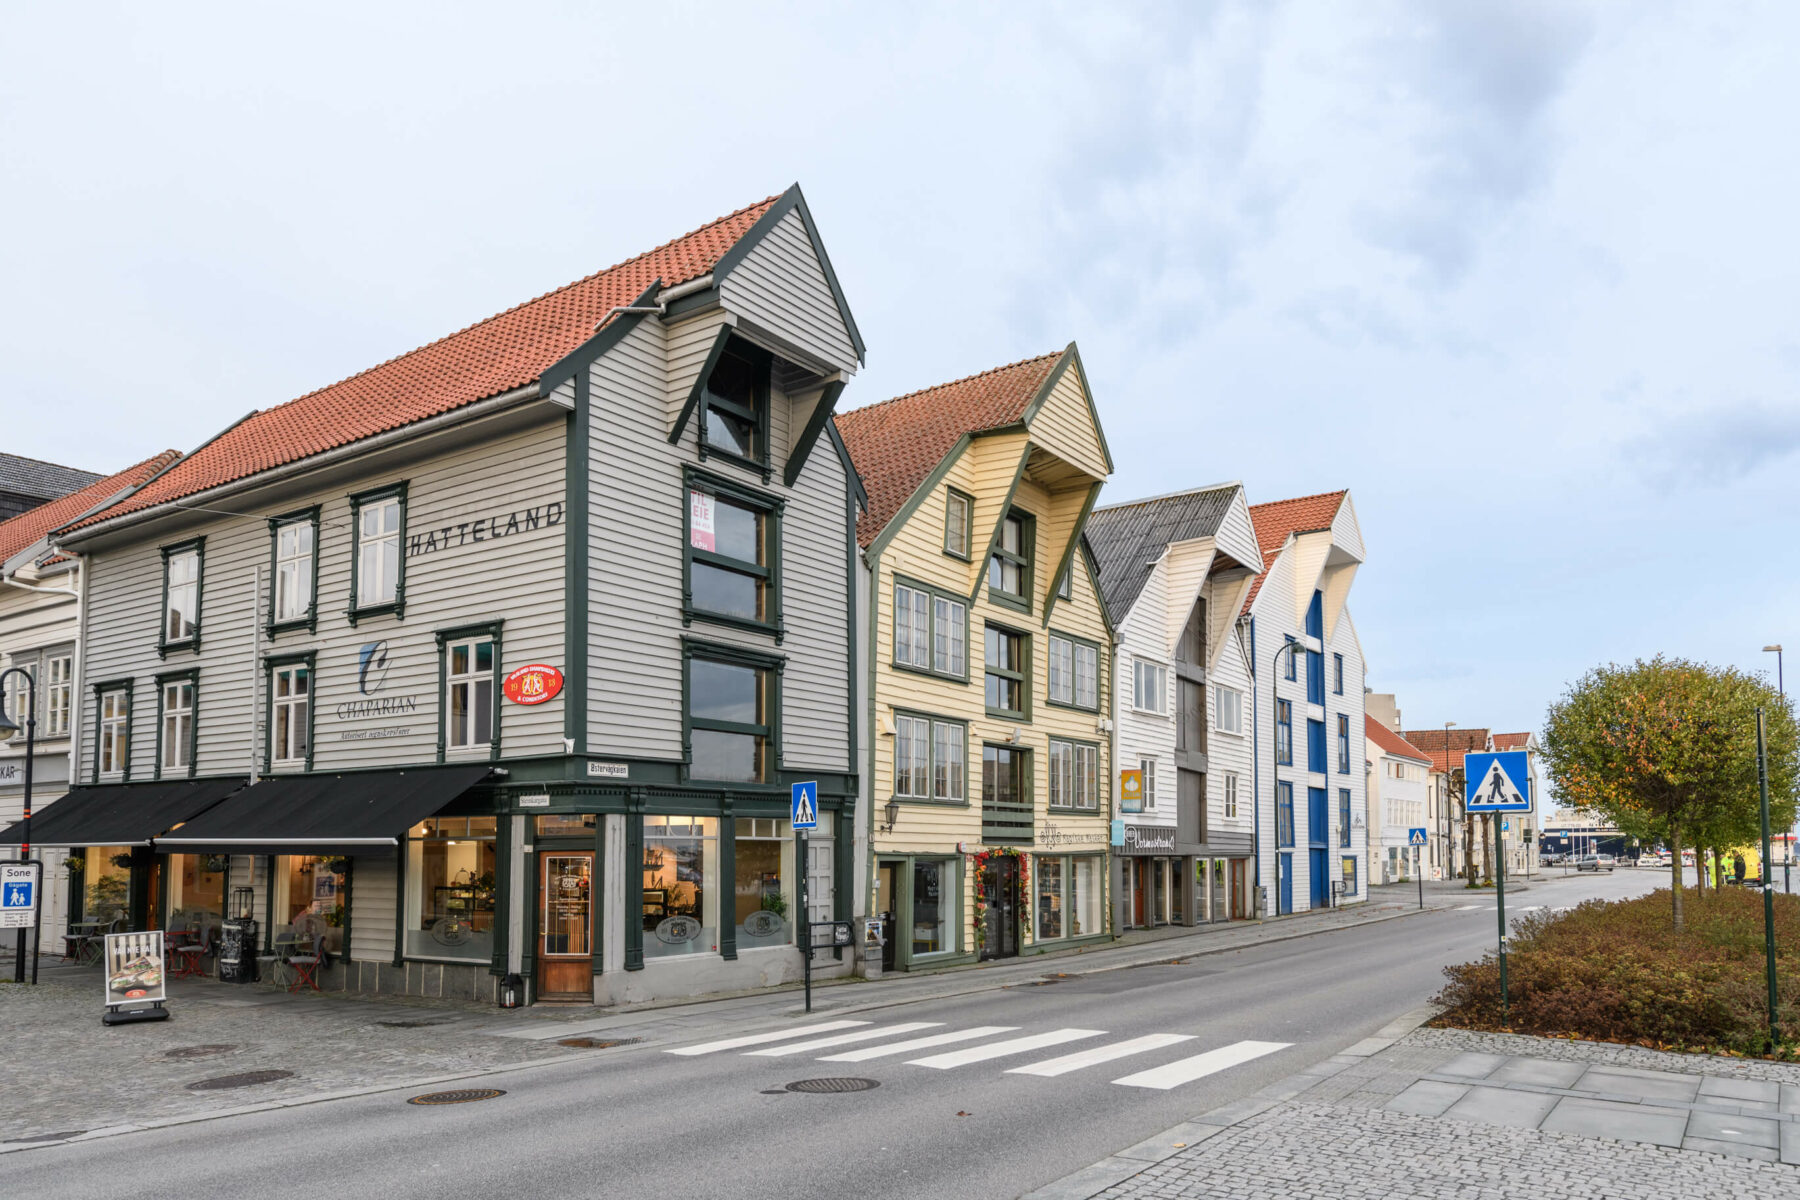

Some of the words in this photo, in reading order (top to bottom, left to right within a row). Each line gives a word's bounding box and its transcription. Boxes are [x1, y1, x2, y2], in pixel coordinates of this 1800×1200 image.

[410, 503, 562, 556] HATTELAND
[511, 683, 518, 691] 19
[337, 694, 417, 719] CHAPARIAN
[6, 869, 31, 877] Sone
